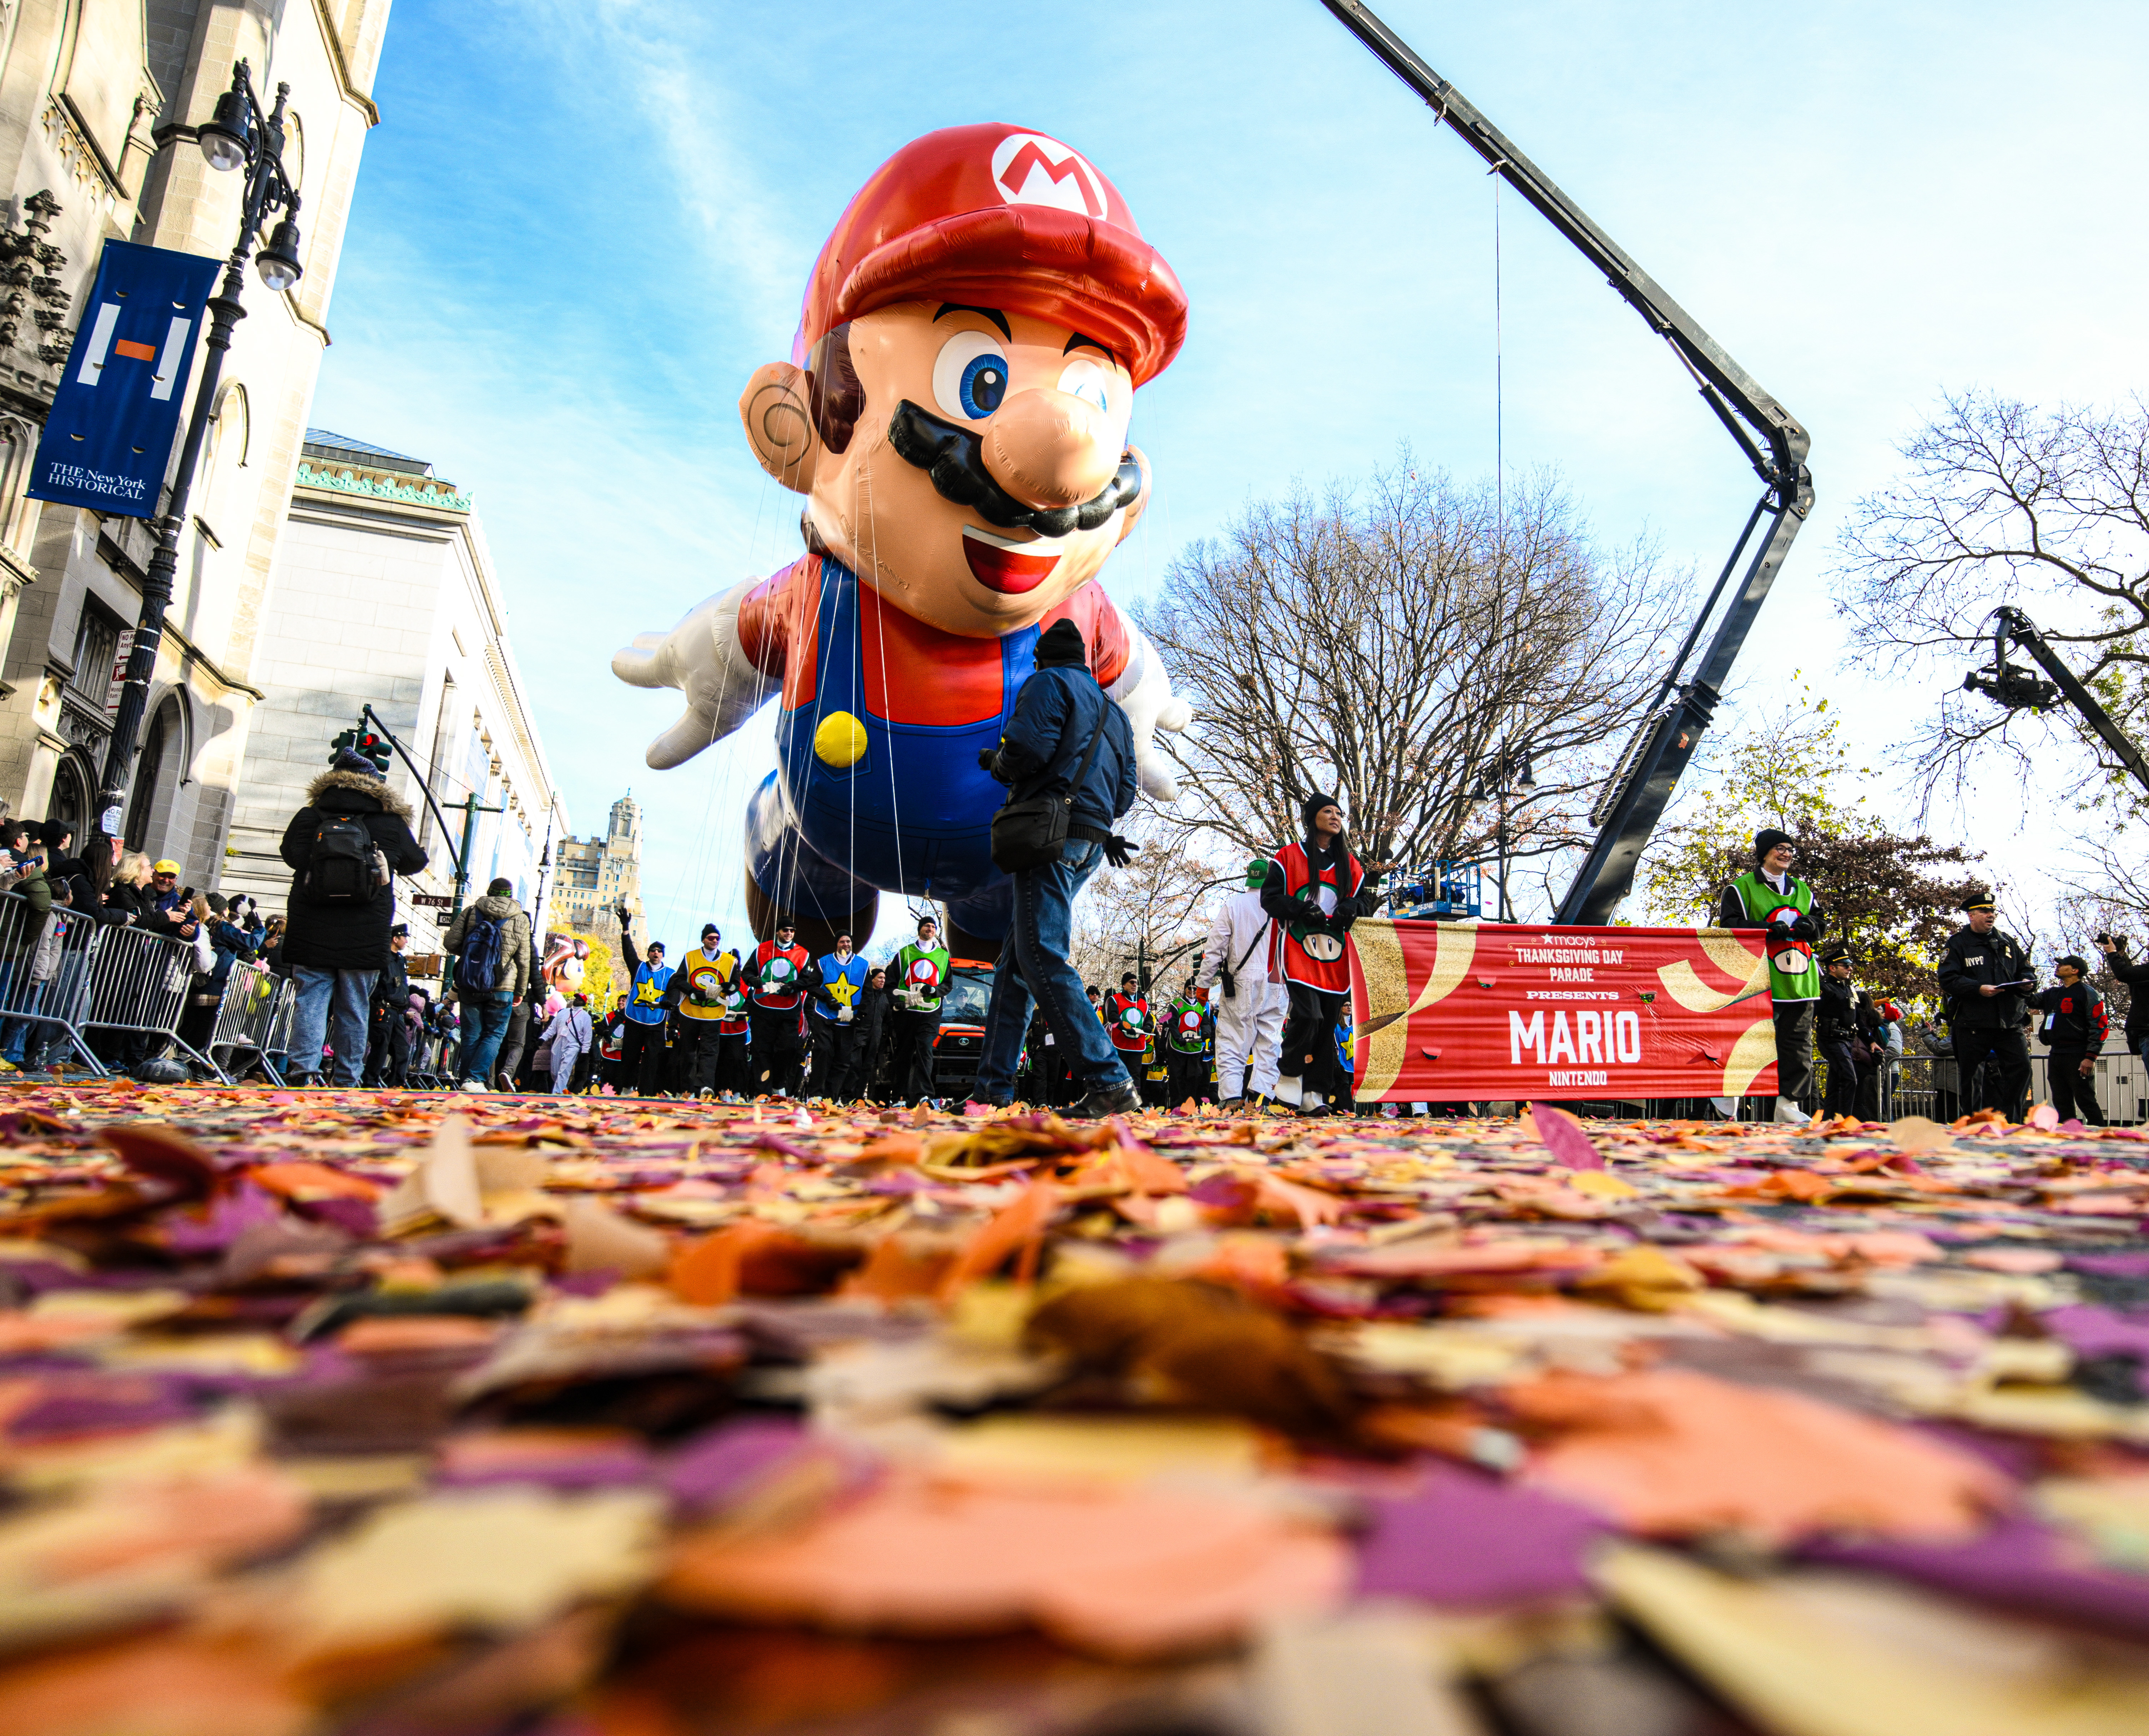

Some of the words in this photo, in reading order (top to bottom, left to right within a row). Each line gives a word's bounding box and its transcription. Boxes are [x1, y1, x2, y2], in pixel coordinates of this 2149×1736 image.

[51, 462, 84, 478] THE
[86, 470, 117, 483] New
[117, 475, 146, 489] York
[48, 473, 143, 499] HISTORICAL
[1554, 936, 1595, 948] macys
[1515, 948, 1600, 964] THANKSGIVING
[1603, 950, 1623, 964] DAY
[1965, 956, 1984, 967] NYPD
[1549, 967, 1594, 982] PARADE
[1526, 991, 1619, 1000] PRESENTS
[1508, 1010, 1641, 1064] MARIO
[1549, 1071, 1607, 1086] NINTENDO
